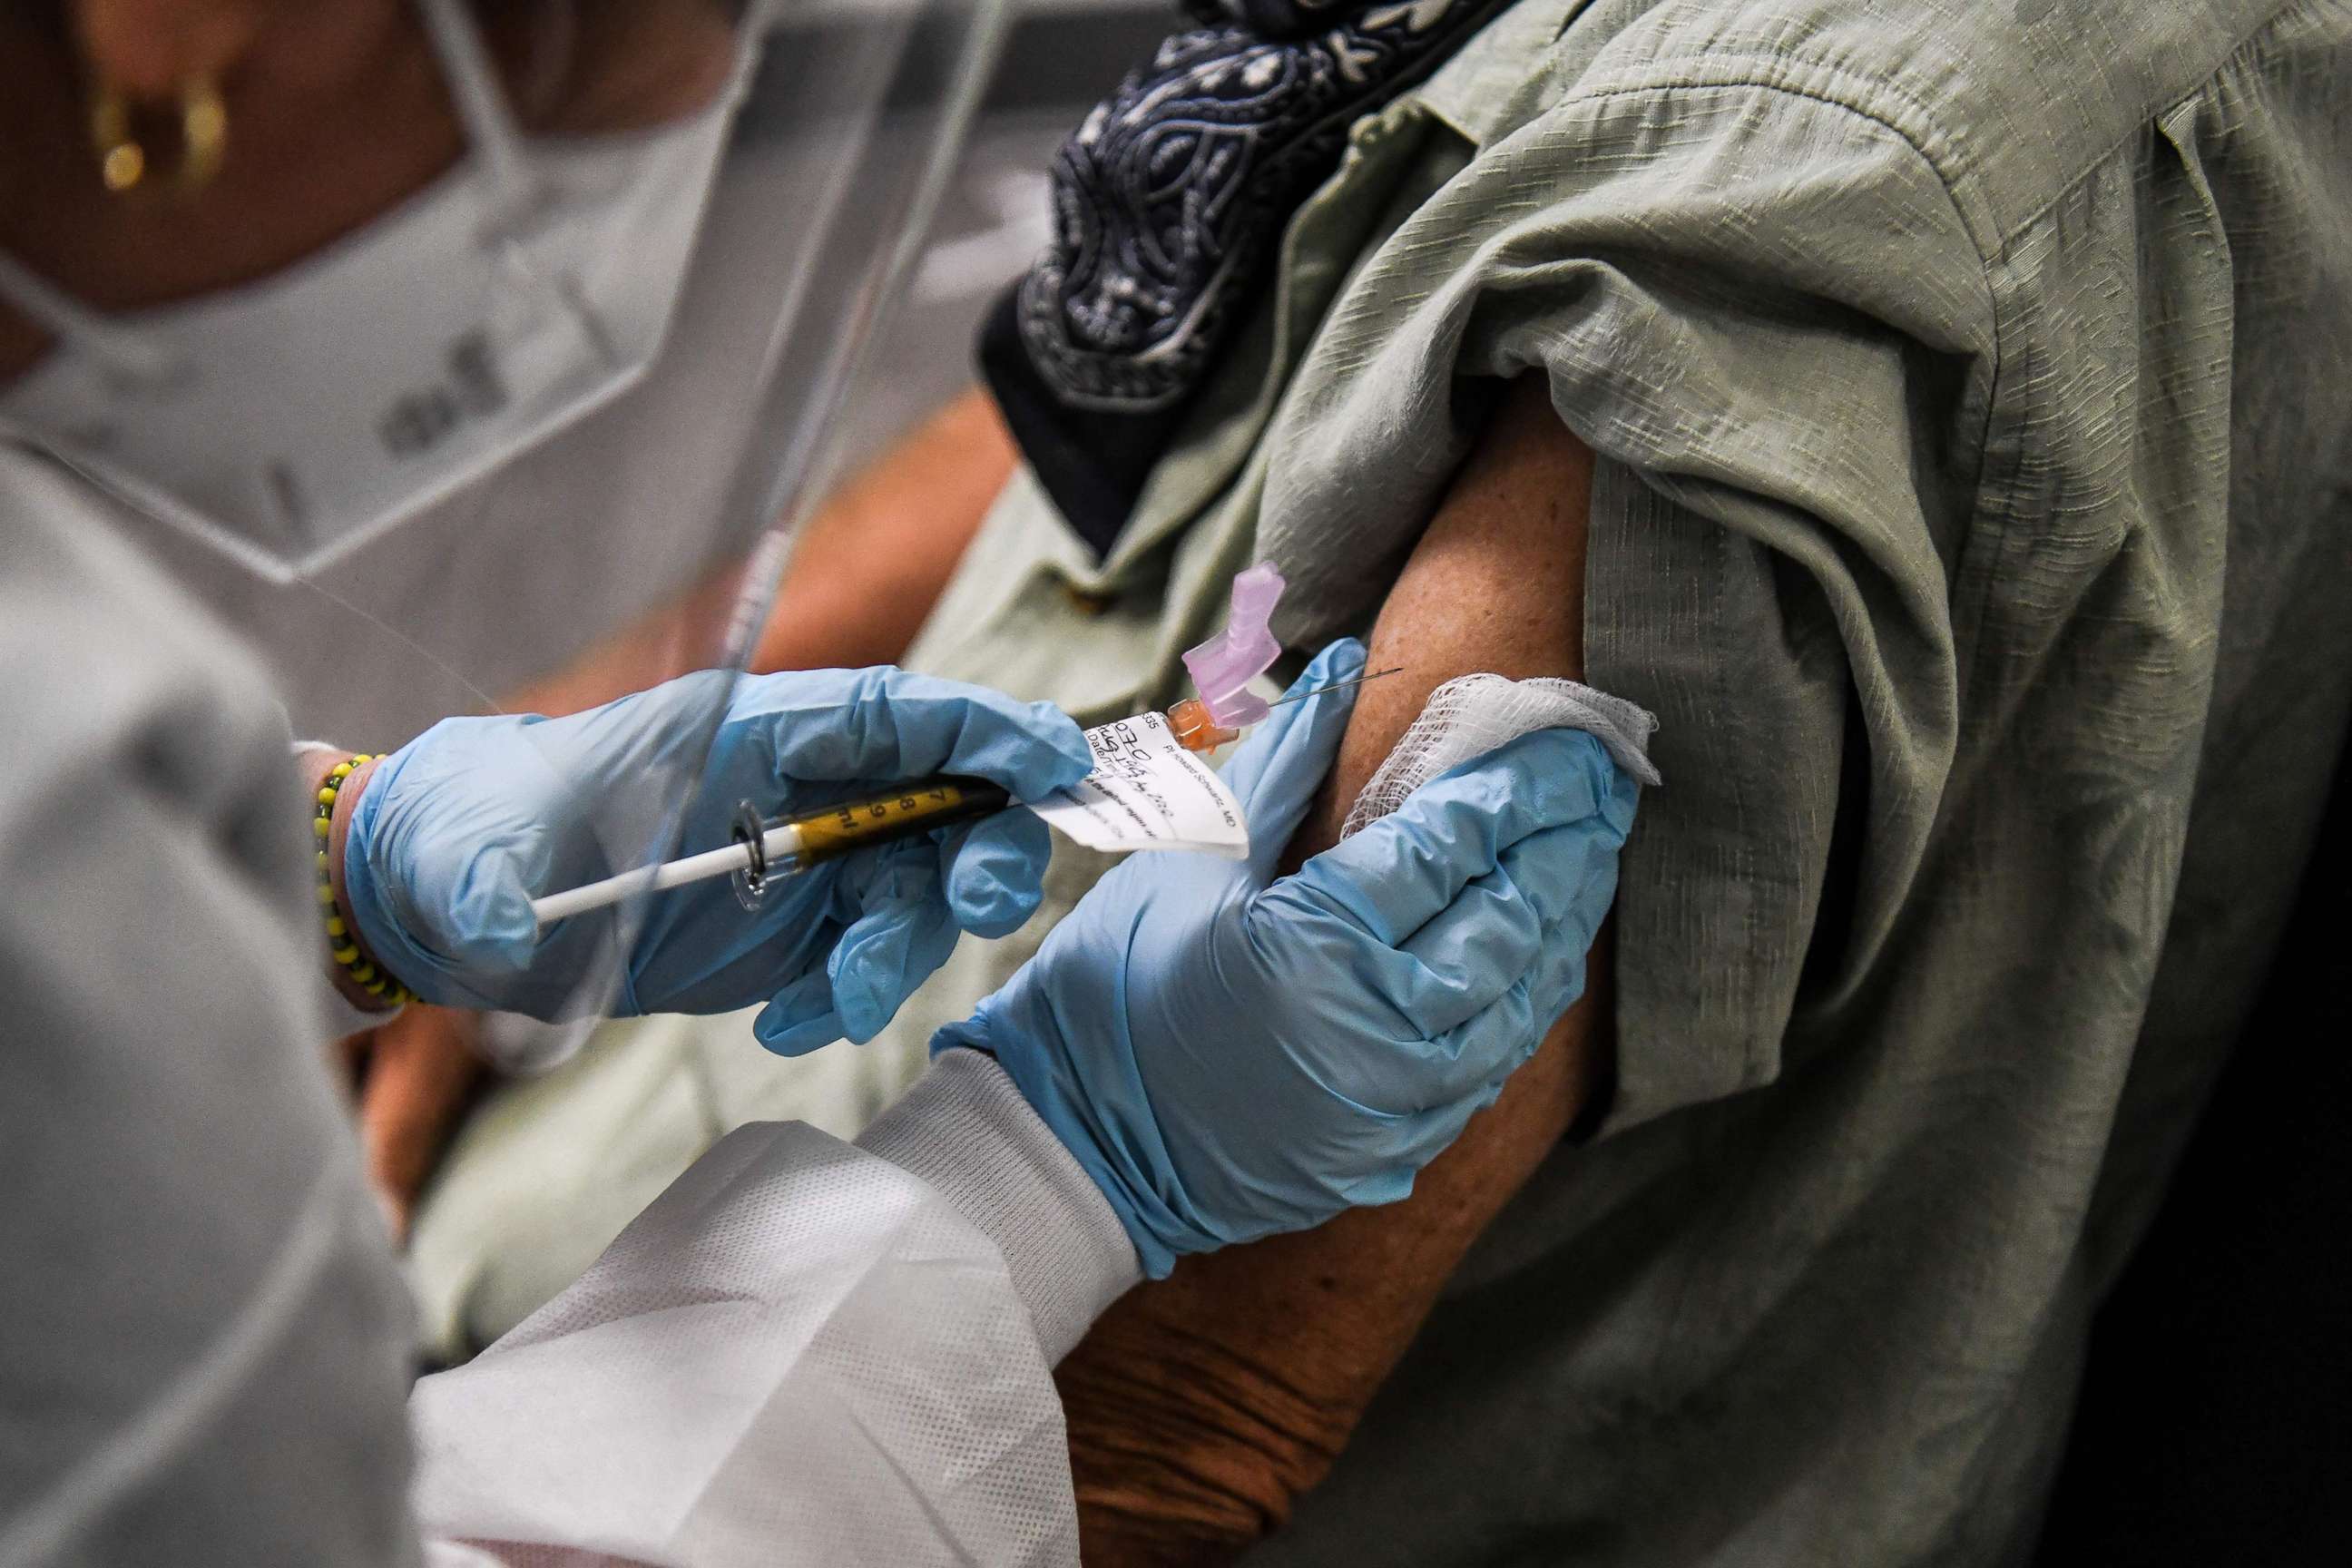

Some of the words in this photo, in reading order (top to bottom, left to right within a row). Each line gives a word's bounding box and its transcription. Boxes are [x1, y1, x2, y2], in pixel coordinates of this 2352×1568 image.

[929, 789, 945, 802] 7
[869, 803, 887, 818] 9
[899, 797, 916, 811] 8
[1223, 809, 1237, 828] MD
